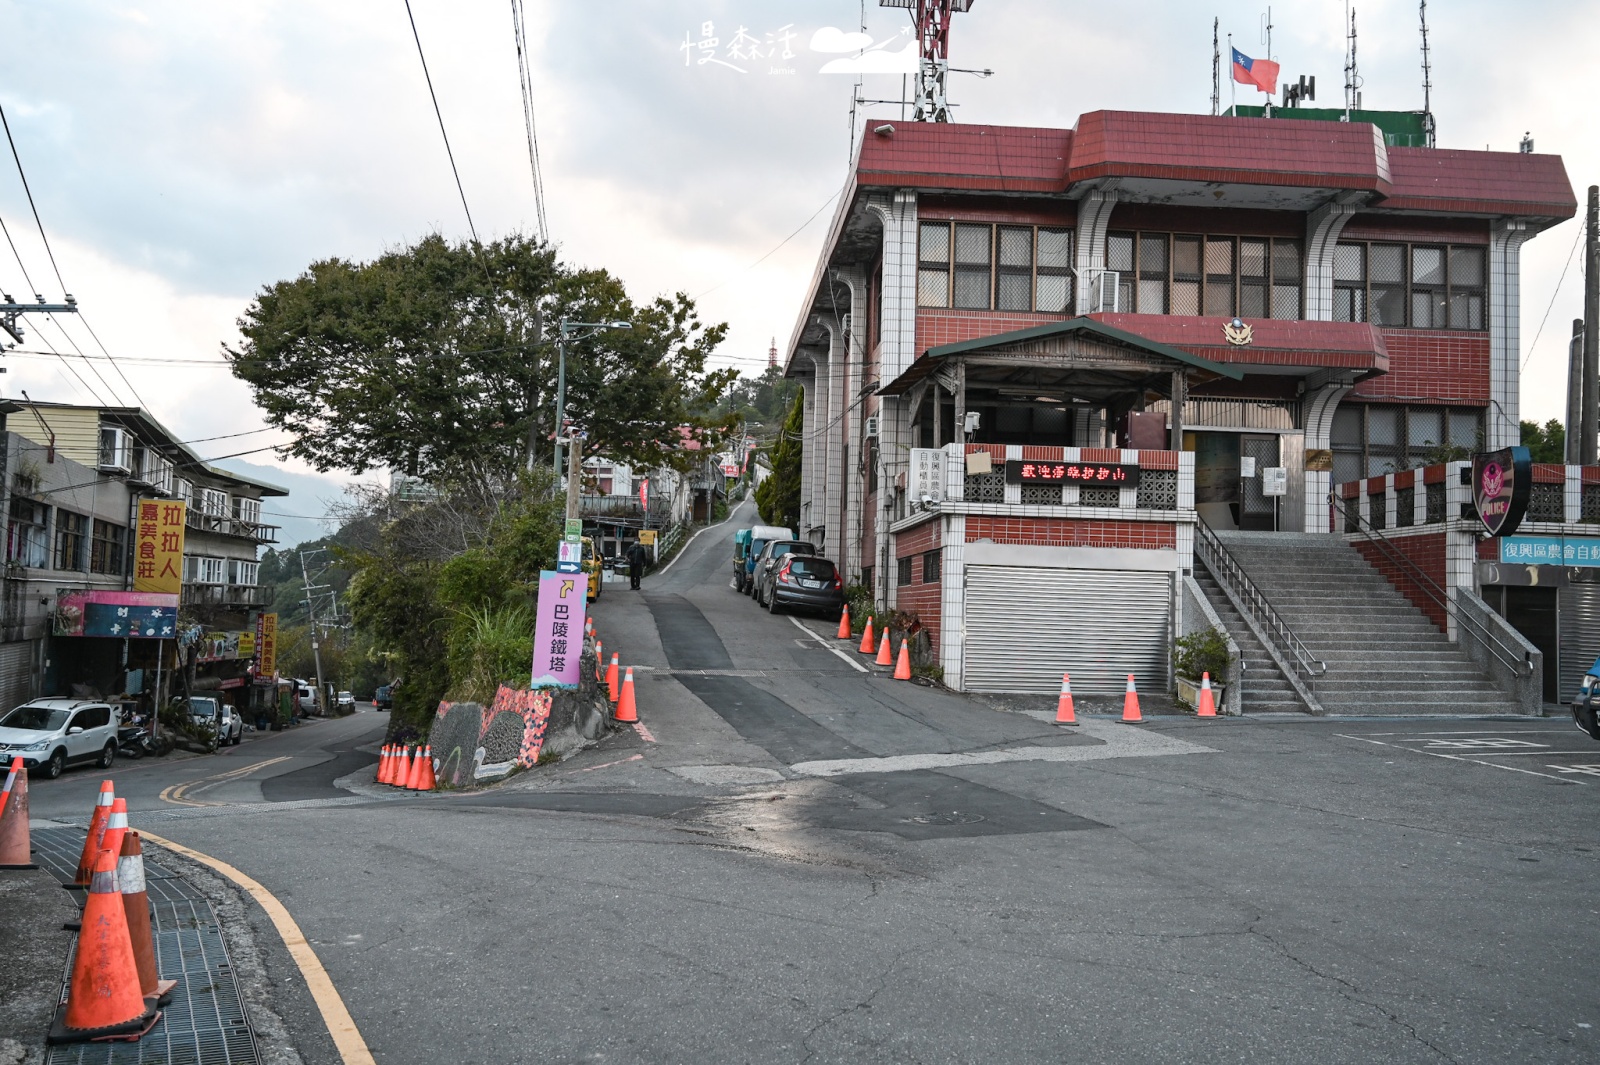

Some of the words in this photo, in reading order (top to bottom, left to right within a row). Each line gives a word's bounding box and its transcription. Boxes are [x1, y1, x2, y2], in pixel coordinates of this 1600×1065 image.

[931, 452, 941, 500] 復興區農會
[1021, 464, 1125, 481] 歡迎蒞臨拉拉山
[1481, 501, 1505, 516] POLICE
[137, 503, 158, 578] 嘉美食莊
[160, 504, 181, 578] 拉拉人
[1504, 542, 1600, 560] 復興區農會自動
[549, 604, 569, 672] 巴陵鐵塔
